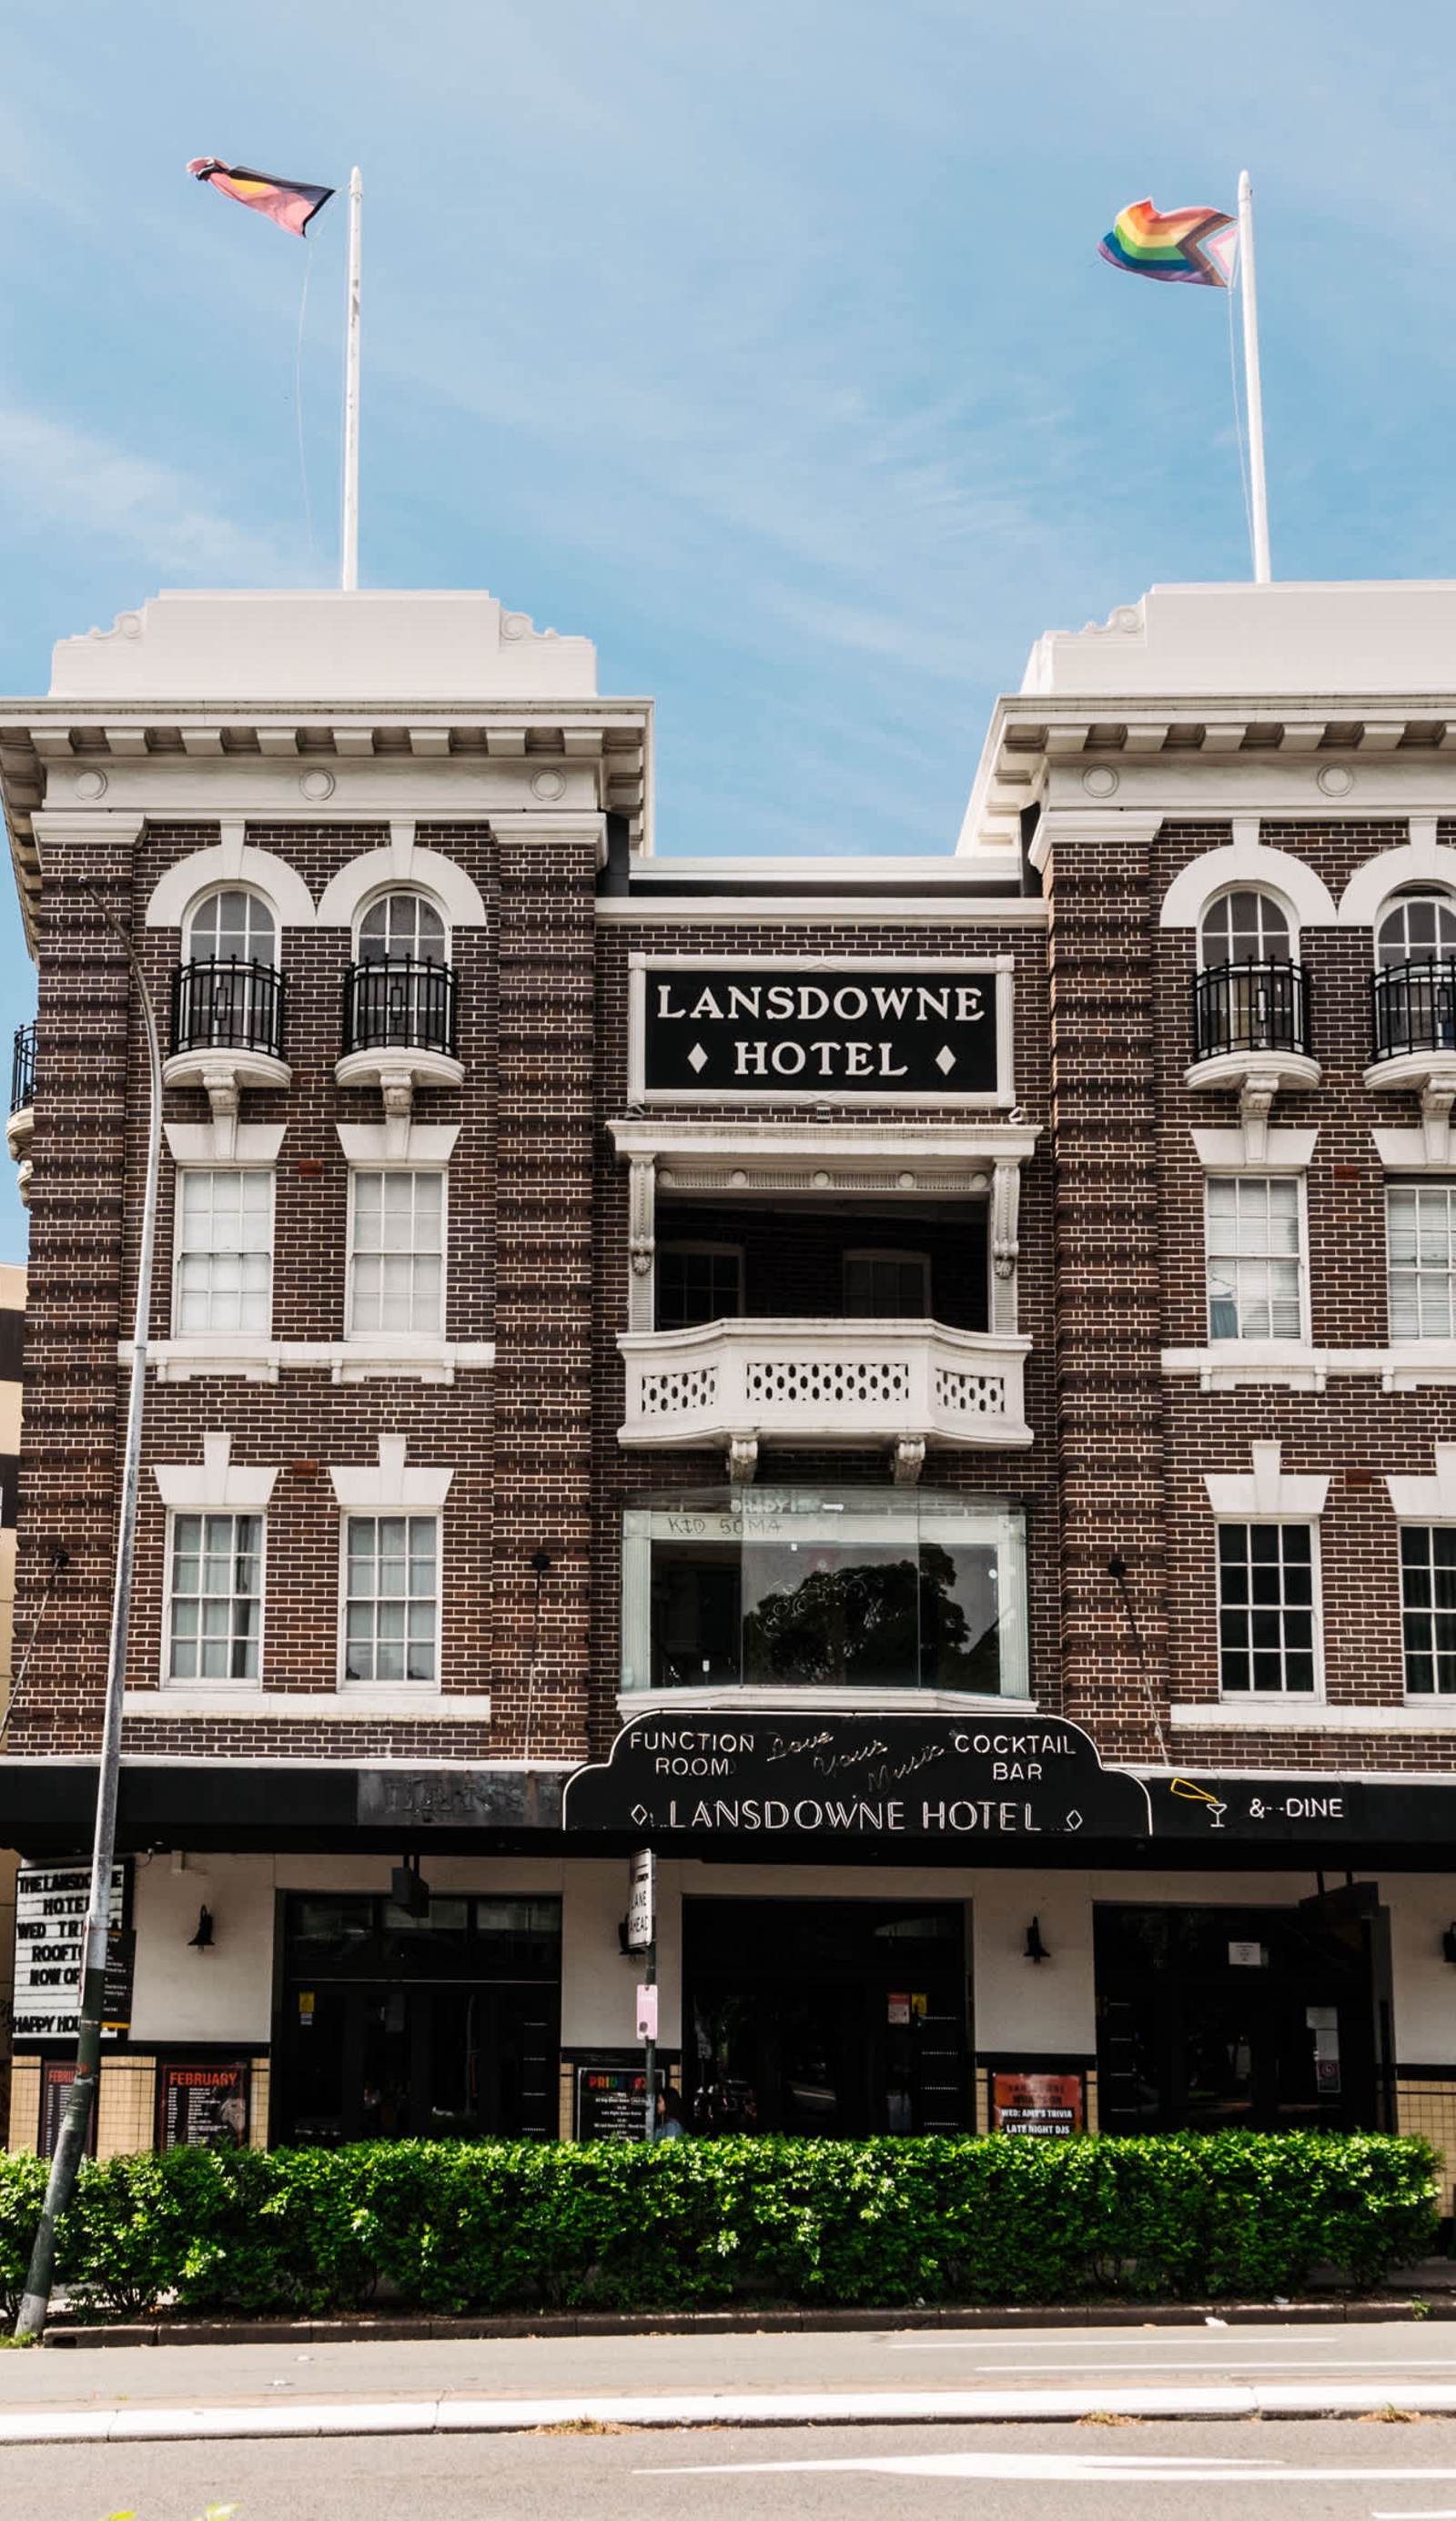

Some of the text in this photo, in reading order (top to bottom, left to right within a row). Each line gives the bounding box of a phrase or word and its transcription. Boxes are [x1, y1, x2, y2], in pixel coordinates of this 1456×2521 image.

[656, 985, 986, 1021] LANSDOWNE
[733, 1041, 909, 1076] HOTEL
[630, 1732, 754, 1753] FUNCTION
[954, 1735, 1077, 1756] COCKTAIL
[655, 1757, 729, 1777] ROOM
[992, 1761, 1043, 1781] BAR
[669, 1799, 1042, 1831] LANSDOWNE HOTEL
[1285, 1797, 1344, 1818] DINE
[17, 1922, 46, 1939] WED
[32, 1944, 83, 1962] ROOFT
[30, 1968, 81, 1986] NOW OP
[14, 2015, 81, 2033] HAPPY HOU
[48, 2070, 74, 2083] FEBRU
[169, 2071, 237, 2086] FEBRUARY
[1047, 2110, 1073, 2119] TRIVIA
[1006, 2124, 1070, 2135] LATE NIGHT DJS
